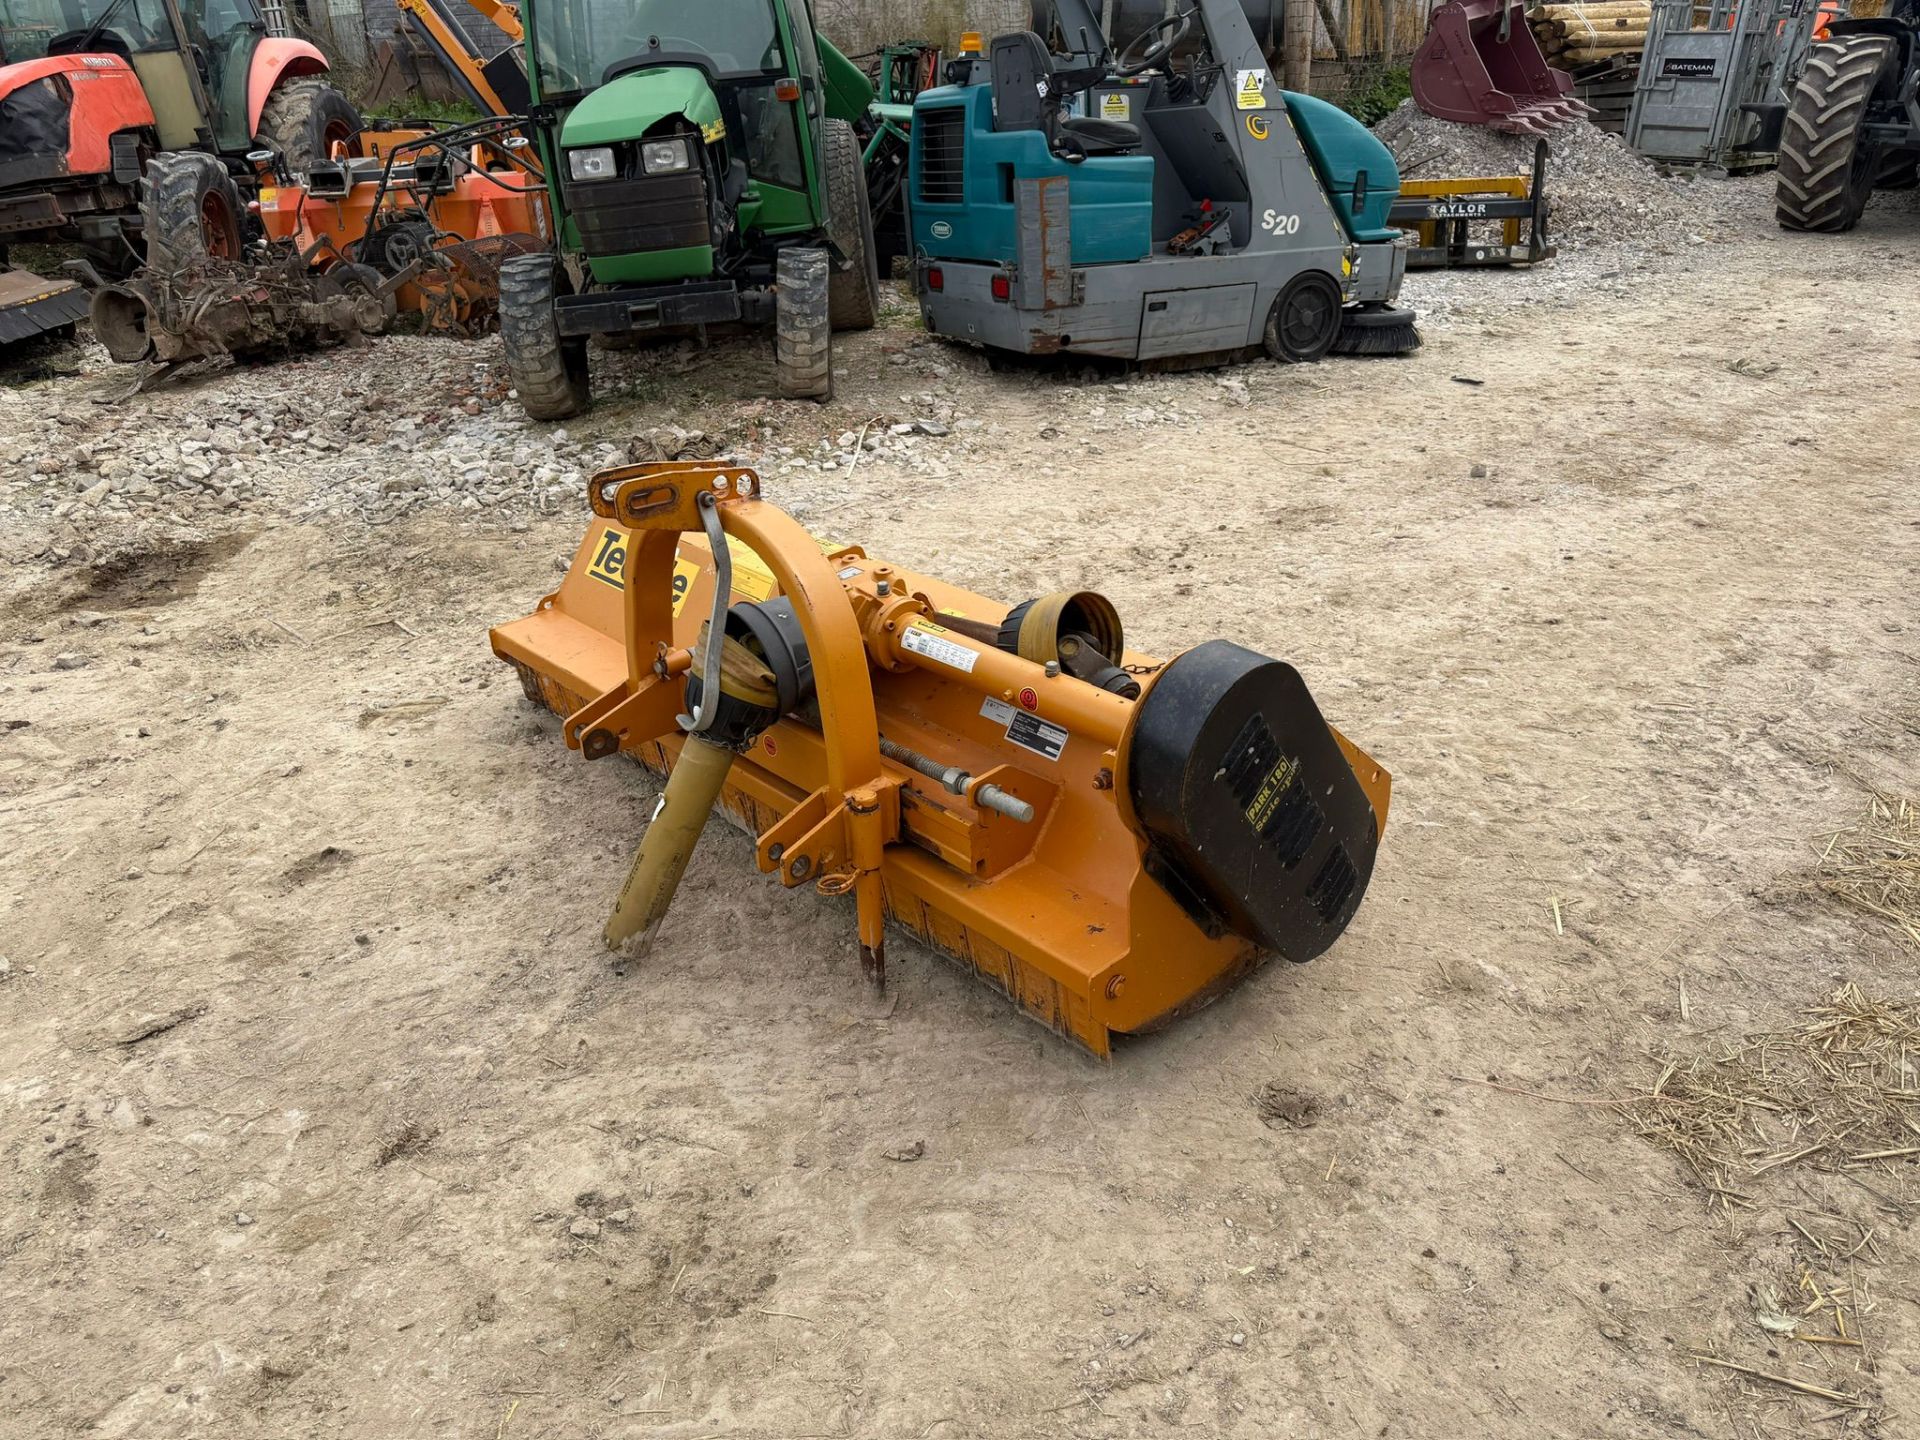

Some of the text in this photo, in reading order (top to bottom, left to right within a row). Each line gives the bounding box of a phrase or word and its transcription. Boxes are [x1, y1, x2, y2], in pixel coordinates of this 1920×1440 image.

[1261, 208, 1300, 236] S20
[1431, 204, 1486, 213] TAYLOR
[1248, 761, 1288, 820] PARK 180
[1255, 796, 1281, 832] Serie
